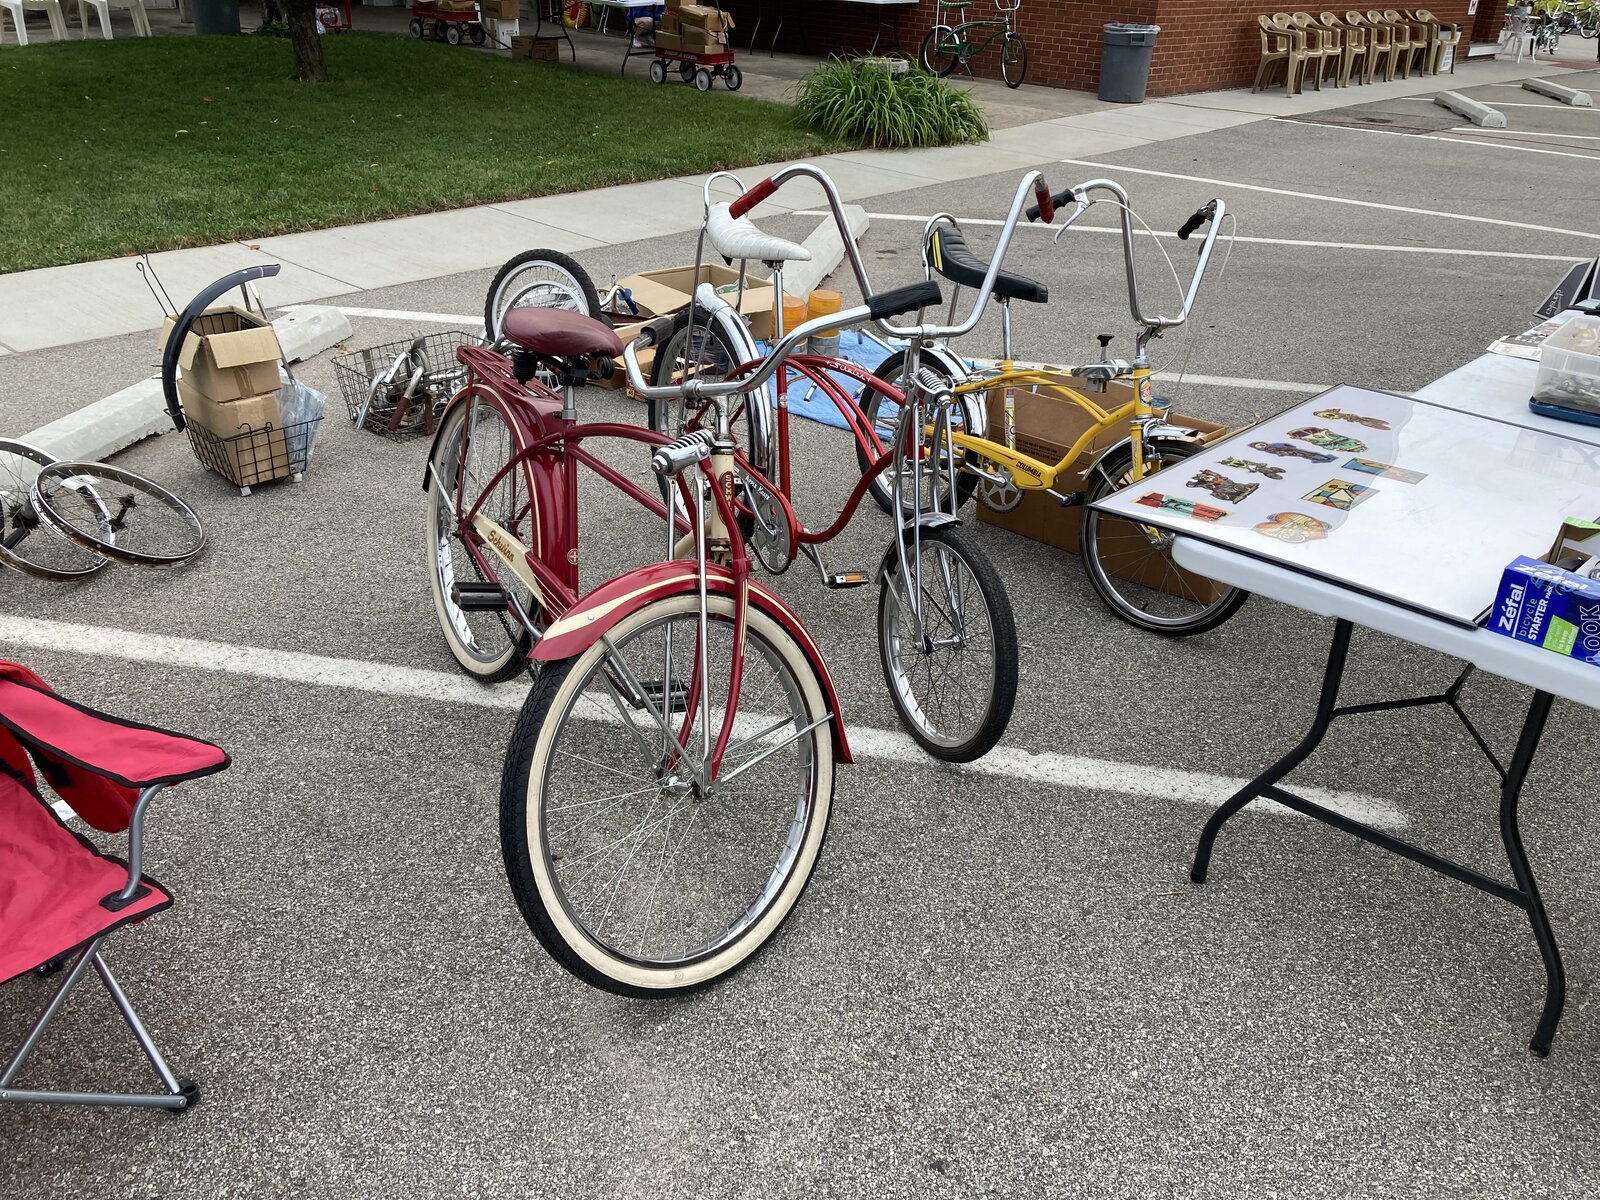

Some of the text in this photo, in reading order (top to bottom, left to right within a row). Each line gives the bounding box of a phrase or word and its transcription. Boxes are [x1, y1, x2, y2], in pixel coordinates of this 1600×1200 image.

[1016, 461, 1042, 478] COLUMBIA
[488, 529, 515, 562] Schwinn
[1498, 583, 1524, 631] Zéfal
[1518, 598, 1538, 637] bicycle
[1528, 585, 1554, 641] STARTER PACK
